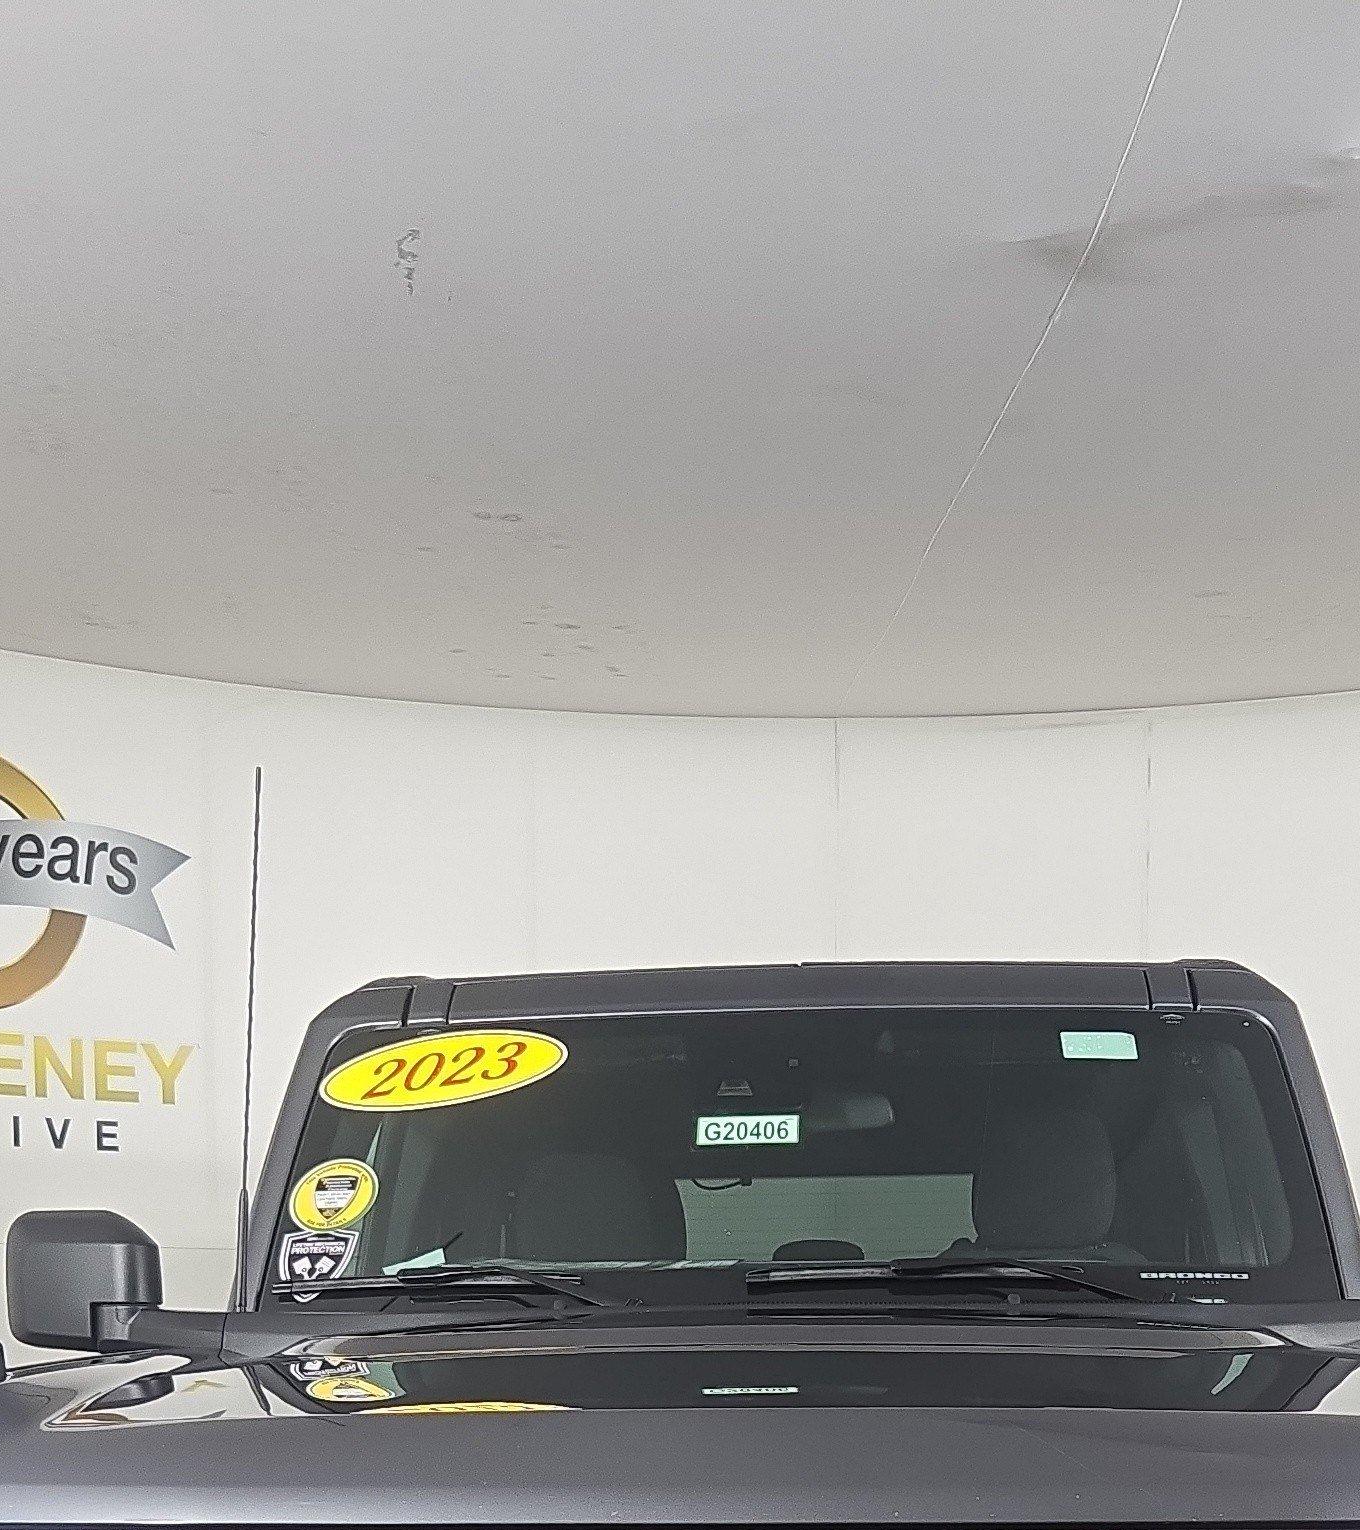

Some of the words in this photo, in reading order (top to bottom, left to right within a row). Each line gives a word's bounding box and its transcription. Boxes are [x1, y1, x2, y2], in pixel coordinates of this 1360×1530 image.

[360, 1041, 528, 1101] 2023
[704, 1120, 789, 1141] G20406
[290, 1245, 346, 1255] PROTECTION
